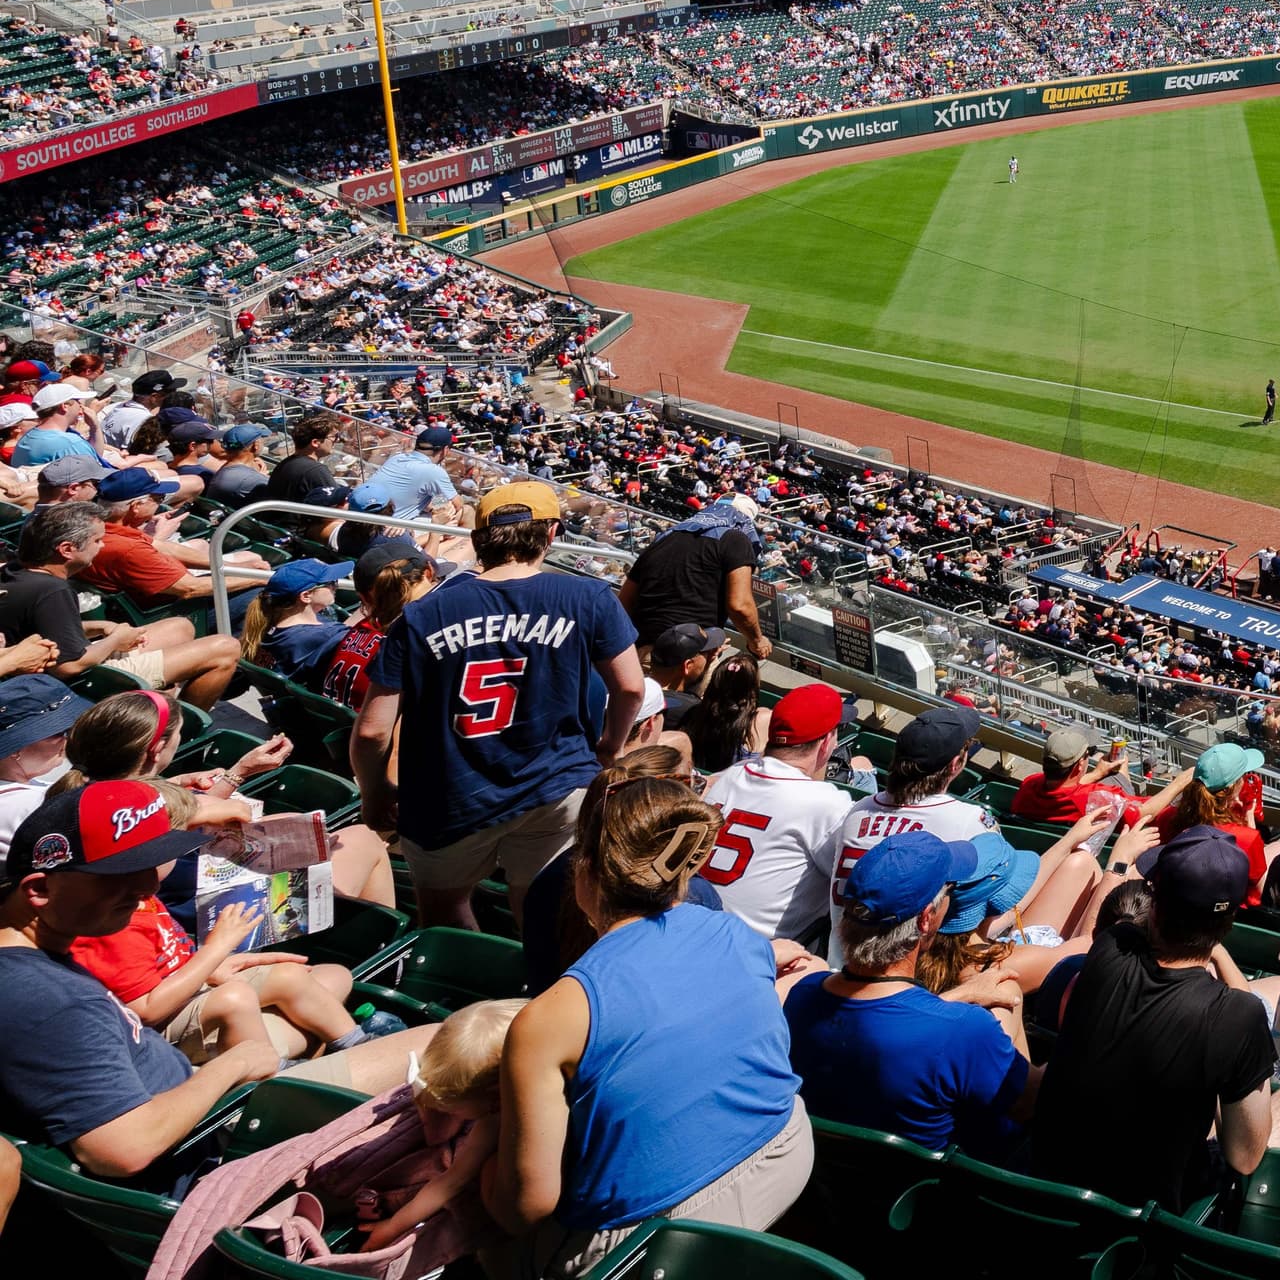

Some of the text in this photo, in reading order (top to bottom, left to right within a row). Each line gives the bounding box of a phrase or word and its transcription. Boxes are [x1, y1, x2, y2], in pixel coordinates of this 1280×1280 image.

[1165, 69, 1241, 91] EQUIFAX
[1042, 80, 1129, 104] QUIKRETE
[934, 97, 1011, 127] xfinity
[16, 103, 209, 171] SOUTH COLLEGE SOUTH.EDU
[612, 122, 629, 135] SEA
[826, 119, 899, 142] Wellstar
[555, 136, 573, 150] LAA
[623, 133, 661, 156] MLB+
[471, 156, 490, 172] AL
[353, 163, 460, 202] GAS SOUTH
[449, 179, 493, 203] MLB+
[628, 176, 655, 191] SOUTH
[629, 181, 662, 198] COLLEGE
[835, 609, 867, 629] CAUTION
[1161, 595, 1211, 617] WELCOME
[1216, 608, 1232, 621] TO
[426, 613, 576, 661] FREEMAN
[322, 659, 361, 710] 41
[454, 657, 528, 739] 5
